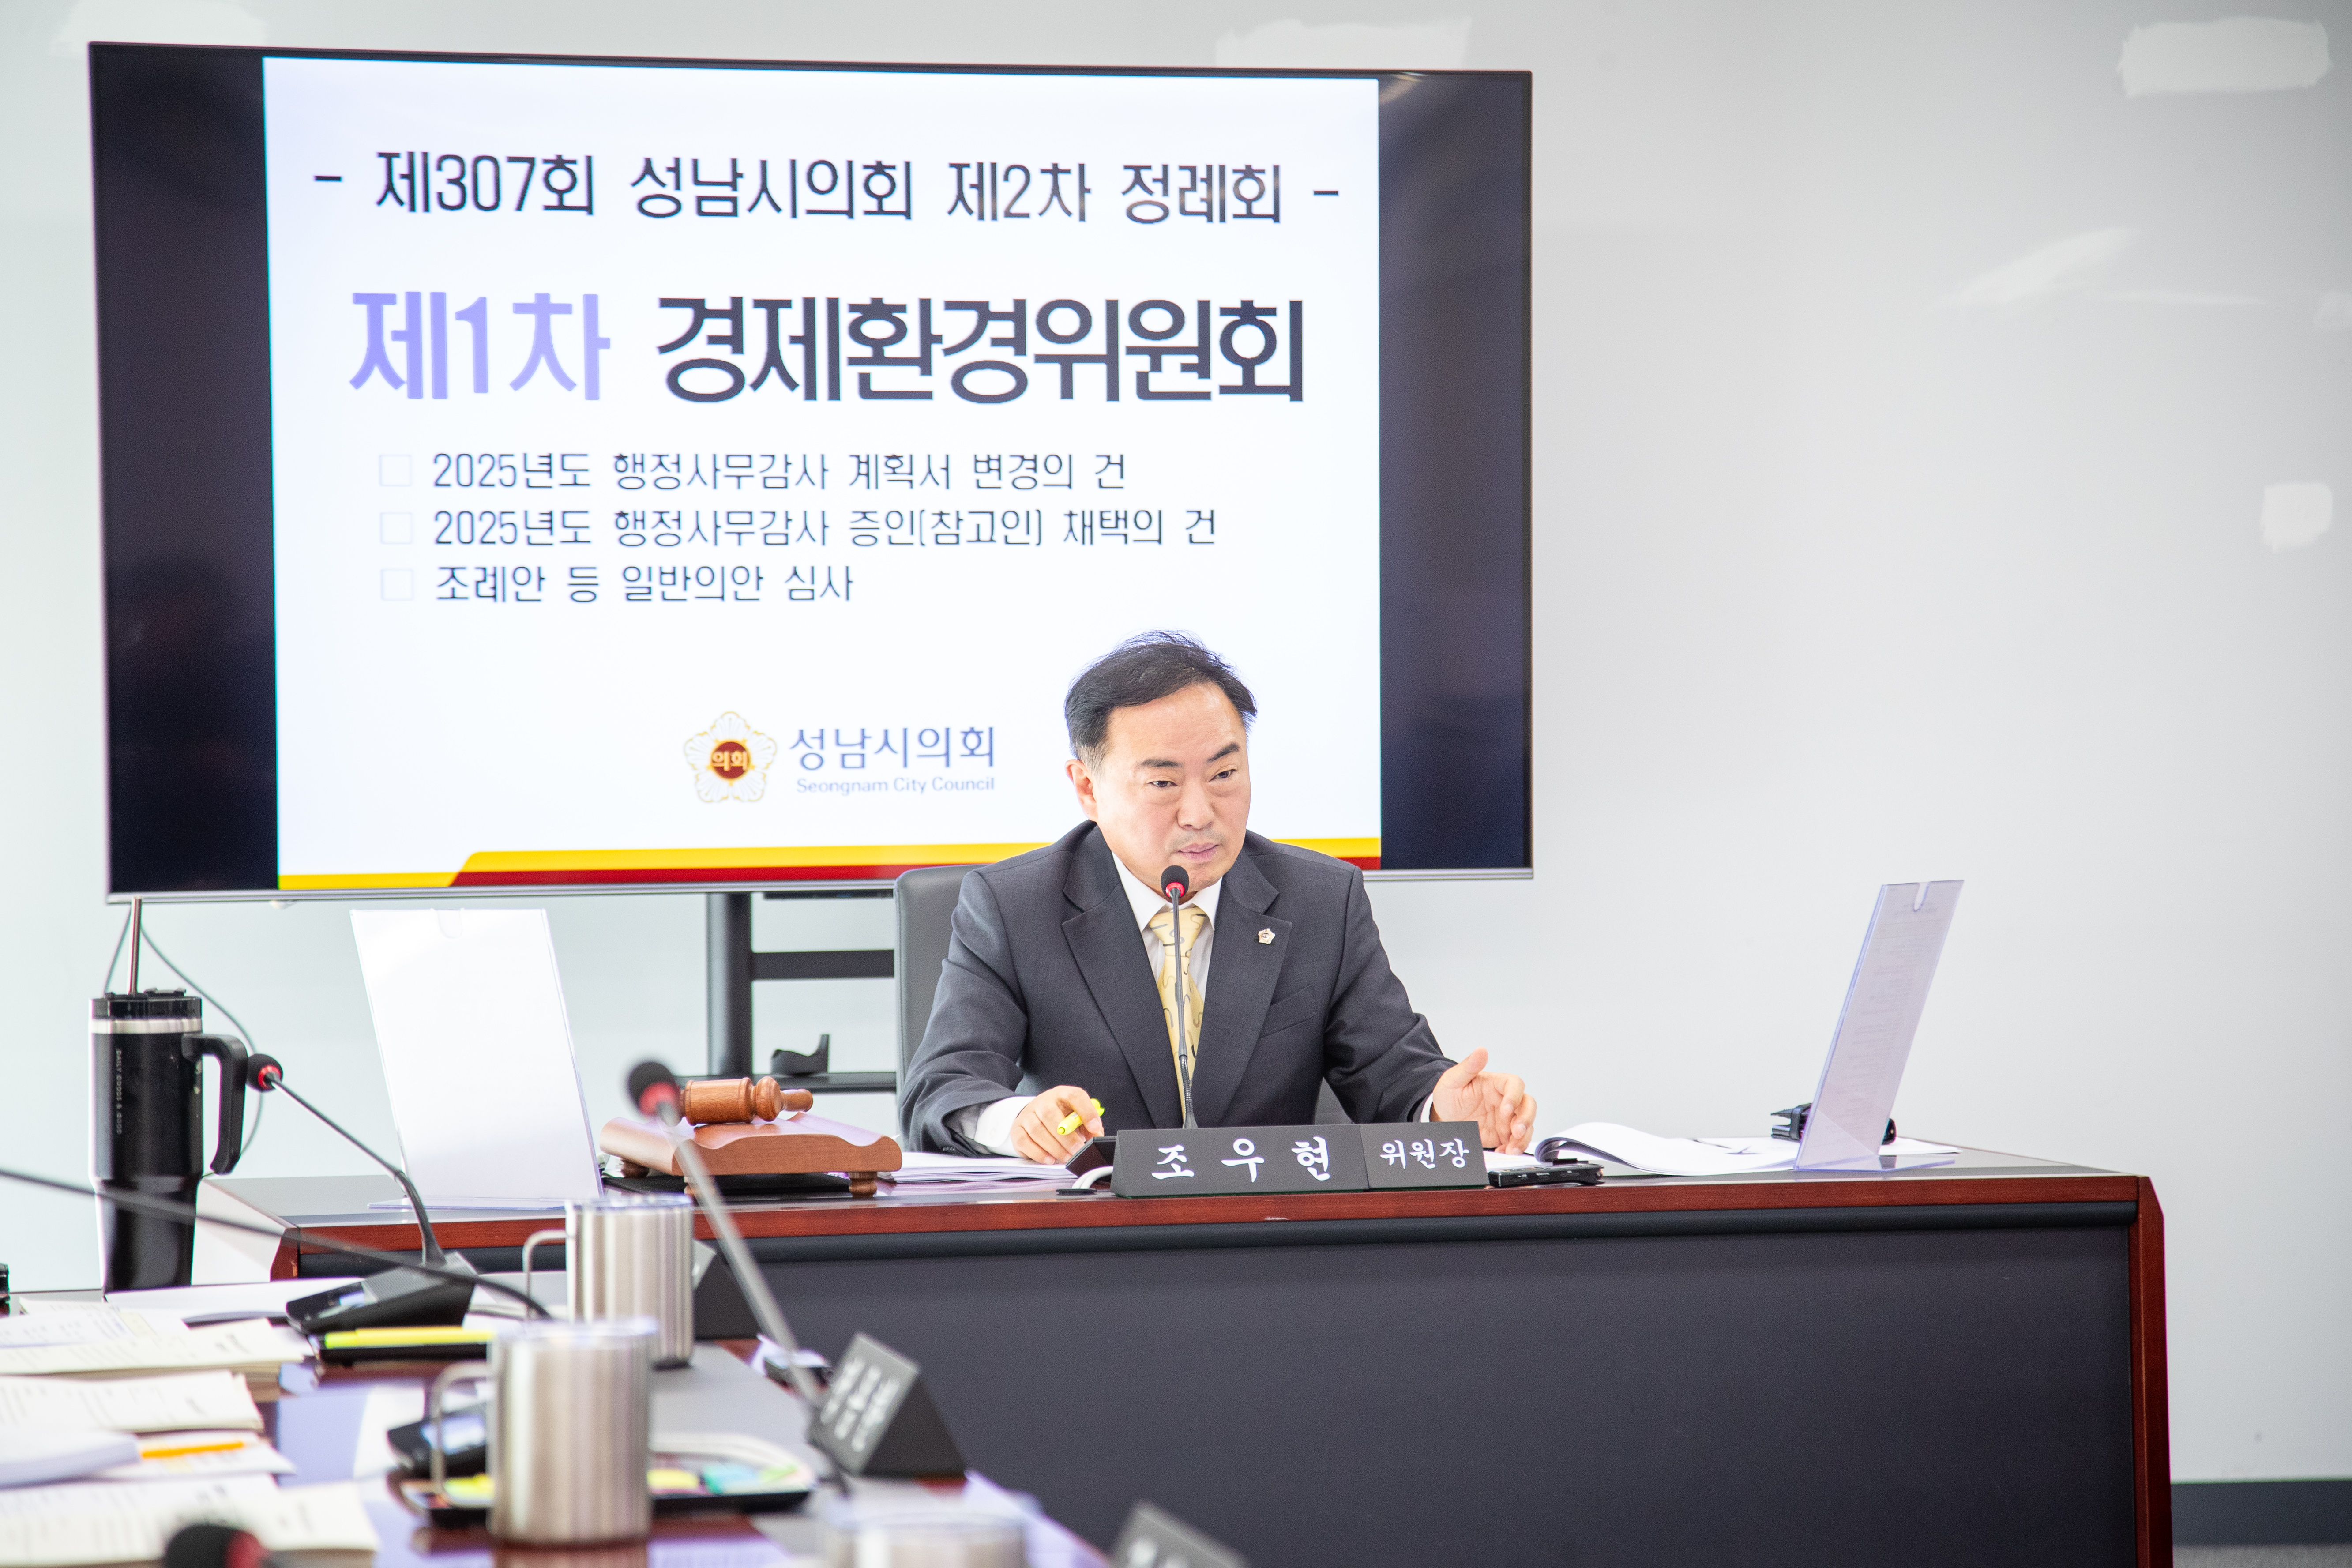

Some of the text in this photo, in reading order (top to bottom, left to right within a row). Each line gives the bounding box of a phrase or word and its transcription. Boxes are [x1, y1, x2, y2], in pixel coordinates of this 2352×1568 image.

[375, 150, 595, 217] 제307회
[630, 157, 913, 221] 성남시의회
[947, 162, 1092, 223] 제2차
[1121, 164, 1281, 226] 정례회
[349, 290, 1304, 405] 제1차 경제환경위원회
[433, 452, 1125, 491] 2025년도 행정사무감사 계획서 변경의 건
[434, 509, 592, 547] 2025년도
[614, 510, 830, 548] 행정사무감사
[1063, 509, 1163, 546] 채택의
[1185, 509, 1215, 545] 건
[436, 565, 854, 604] 조례안 등 일반의안 심사
[712, 751, 748, 771] 의회
[790, 726, 994, 771] 성남시의회
[797, 776, 995, 795] Seongnam City Council
[1379, 1137, 1470, 1169] 위원장
